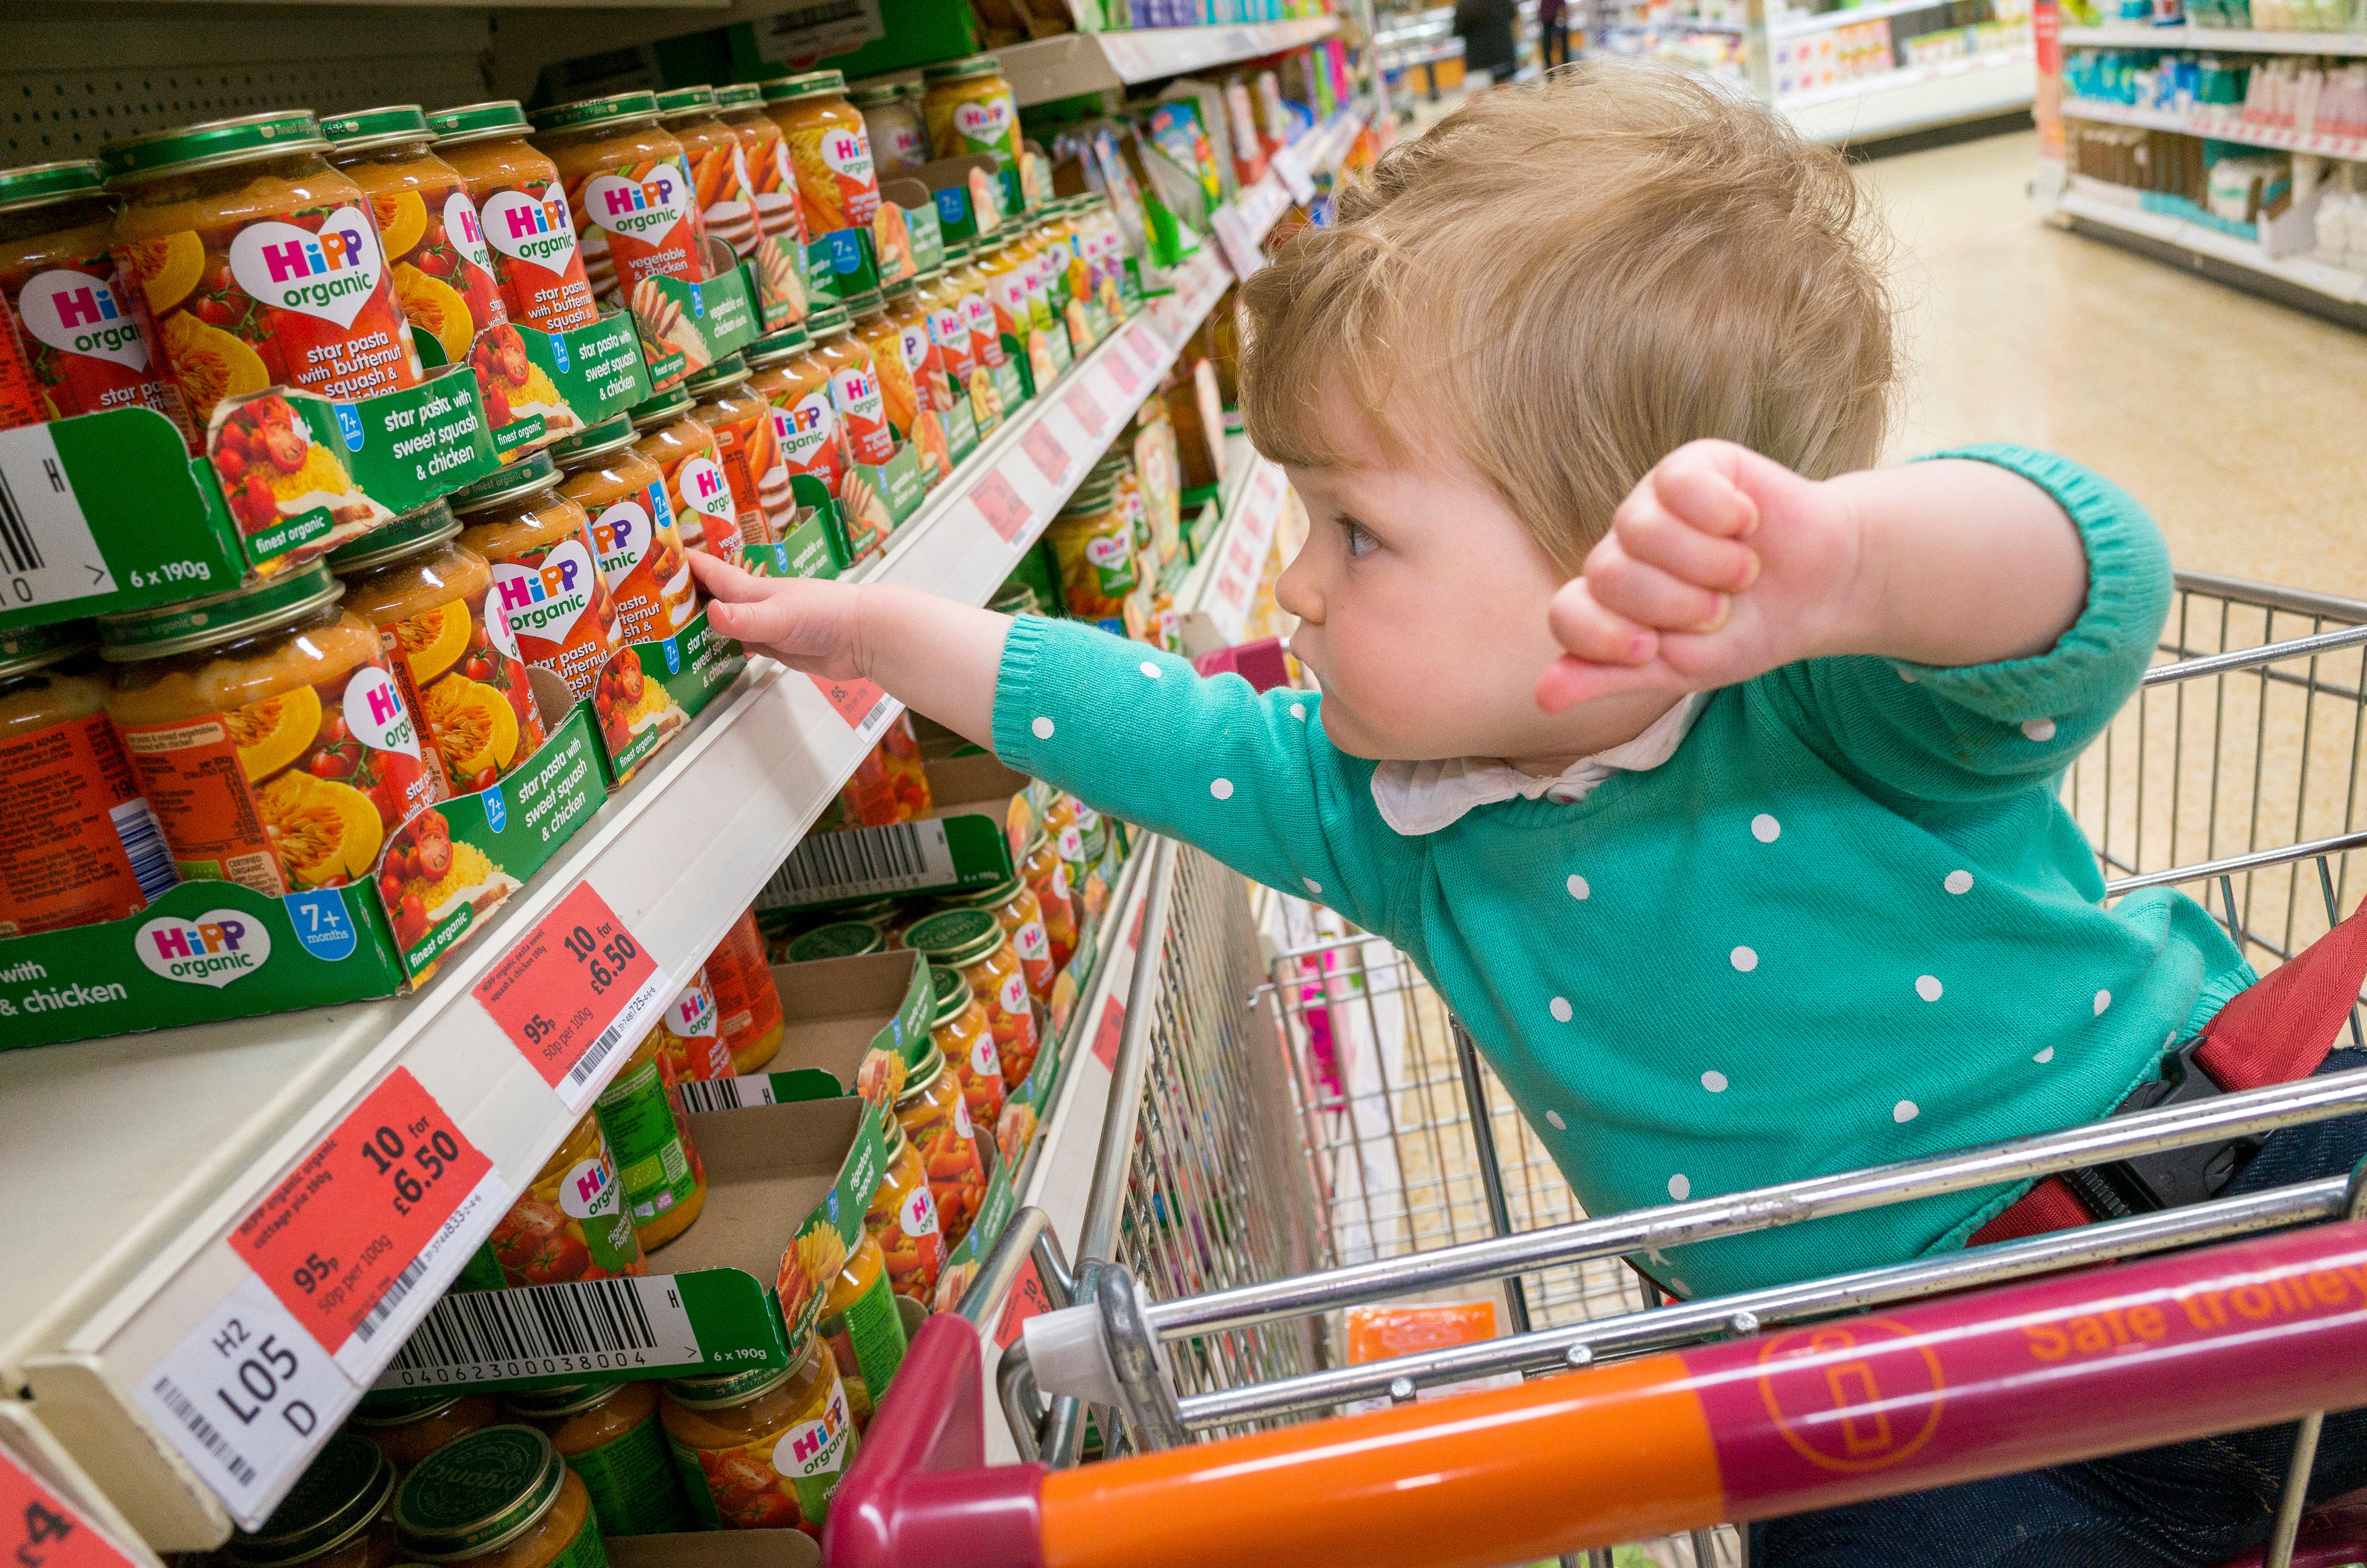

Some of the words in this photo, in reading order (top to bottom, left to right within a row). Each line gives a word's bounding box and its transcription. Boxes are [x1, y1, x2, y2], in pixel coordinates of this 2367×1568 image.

[605, 179, 673, 215] HiPP
[460, 211, 483, 243] Hi
[505, 199, 566, 239] HiPP
[616, 208, 678, 232] organic
[262, 229, 362, 283] HiPP
[519, 232, 574, 258] organic
[628, 247, 686, 269] vegetable
[634, 270, 643, 281] &
[645, 260, 688, 278] chicken
[284, 271, 373, 307] organic
[535, 289, 559, 303] star
[561, 279, 586, 296] pasta
[528, 305, 551, 320] with
[554, 294, 593, 313] butternut
[547, 309, 586, 330] squash
[74, 323, 142, 352] orga
[307, 344, 343, 364] star
[347, 331, 389, 355] pasta
[554, 341, 564, 357] 7+
[579, 345, 596, 360] star
[599, 337, 617, 356] pasta
[619, 330, 632, 344] with
[298, 366, 331, 384] with
[333, 344, 402, 376] butternut
[585, 362, 609, 383] sweet
[611, 348, 636, 373] squash
[100, 385, 136, 406] star
[325, 368, 386, 397] squash
[388, 367, 397, 380] &
[600, 389, 606, 401] &
[607, 375, 635, 398] chicken
[340, 412, 356, 432] 7+
[385, 409, 415, 432] star
[419, 399, 451, 428] pasta
[454, 389, 472, 408] with
[393, 429, 436, 459] sweet
[439, 411, 478, 442] squash
[498, 430, 517, 446] finest
[518, 421, 541, 438] organic
[43, 458, 65, 493] H
[417, 465, 426, 481] &
[429, 445, 474, 474] chicken
[655, 496, 667, 513] 7+
[255, 532, 286, 554] finest
[289, 515, 325, 541] organic
[592, 519, 632, 554] PP
[130, 570, 144, 588] 6
[147, 572, 162, 586] x
[160, 560, 211, 581] 190g
[603, 551, 638, 572] anic
[498, 559, 578, 611] HiPP
[510, 593, 586, 631] organic
[644, 622, 652, 631] &
[559, 641, 597, 663] pasta
[667, 645, 676, 660] 7+
[687, 635, 700, 654] star
[692, 648, 712, 675] sweet
[568, 674, 592, 692] ash
[703, 677, 709, 688] &
[709, 652, 732, 682] chicken
[366, 682, 402, 727] Hi
[619, 748, 634, 767] finest
[634, 731, 655, 756] organic
[518, 780, 539, 804] star
[540, 749, 566, 783] pasta
[566, 737, 581, 760] with
[406, 781, 425, 801] star
[489, 798, 501, 816] 7+
[525, 795, 556, 828] sweet
[557, 758, 587, 796] squash
[542, 827, 550, 841] &
[551, 791, 586, 834] chicken
[301, 904, 340, 932] 7+
[151, 920, 245, 959] HiPP
[307, 929, 349, 944] months
[410, 938, 436, 968] finest
[437, 912, 468, 945] organic
[564, 926, 596, 963] 10
[596, 922, 613, 939] for
[0, 962, 47, 984] with
[170, 952, 254, 979] organic
[591, 933, 636, 996] £6.50
[0, 999, 18, 1016] &
[23, 981, 128, 1014] chicken
[524, 1014, 556, 1045] 95p
[543, 1041, 562, 1061] 50p
[559, 1026, 575, 1045] per
[571, 1007, 595, 1030] 100g
[763, 1087, 773, 1105] H
[361, 1126, 405, 1176] 10
[408, 1116, 431, 1139] for
[393, 1129, 459, 1216] £6.50
[851, 1139, 872, 1191] rigatoni
[856, 1161, 874, 1206] napoli
[293, 1252, 339, 1295] 95p
[667, 1290, 680, 1309] H
[792, 1317, 807, 1341] finest
[807, 1288, 823, 1319] organic
[212, 1319, 251, 1358] H2
[2023, 1304, 2168, 1362] Safe
[712, 1350, 722, 1362] 6
[725, 1351, 733, 1361] x
[734, 1346, 767, 1362] 190g
[283, 1400, 318, 1438] D
[792, 1395, 842, 1463] HiPP
[804, 1420, 849, 1475] organic
